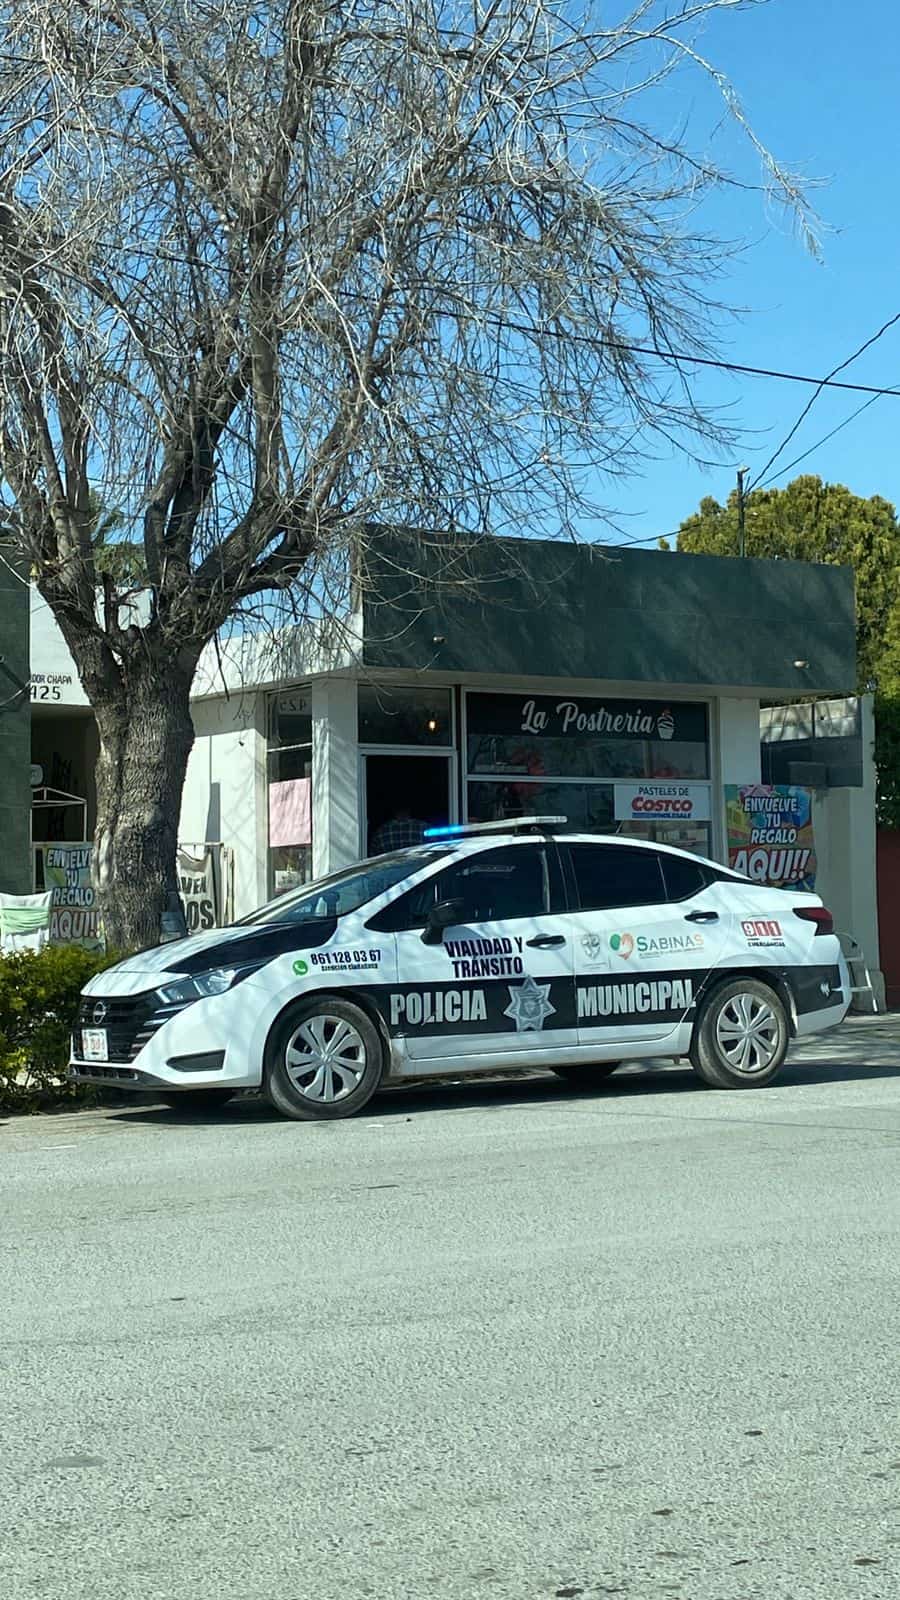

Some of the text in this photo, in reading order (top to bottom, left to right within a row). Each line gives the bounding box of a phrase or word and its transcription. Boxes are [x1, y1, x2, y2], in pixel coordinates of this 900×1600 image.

[47, 674, 72, 685] CHAPA
[521, 700, 549, 734] La
[639, 786, 689, 796] PASTELES DE
[631, 797, 693, 812] COSTCO
[744, 798, 797, 812] ENVUELVE
[767, 813, 781, 828] TU
[751, 828, 797, 844] REGALO
[734, 849, 811, 882] AQUI!!
[53, 887, 94, 906] REGALO
[743, 922, 780, 936] 911
[444, 936, 522, 958] VIALIDAD Y
[311, 949, 381, 965] 861 128 03 67
[390, 979, 697, 1024] POLICIA MUNICIPAL
